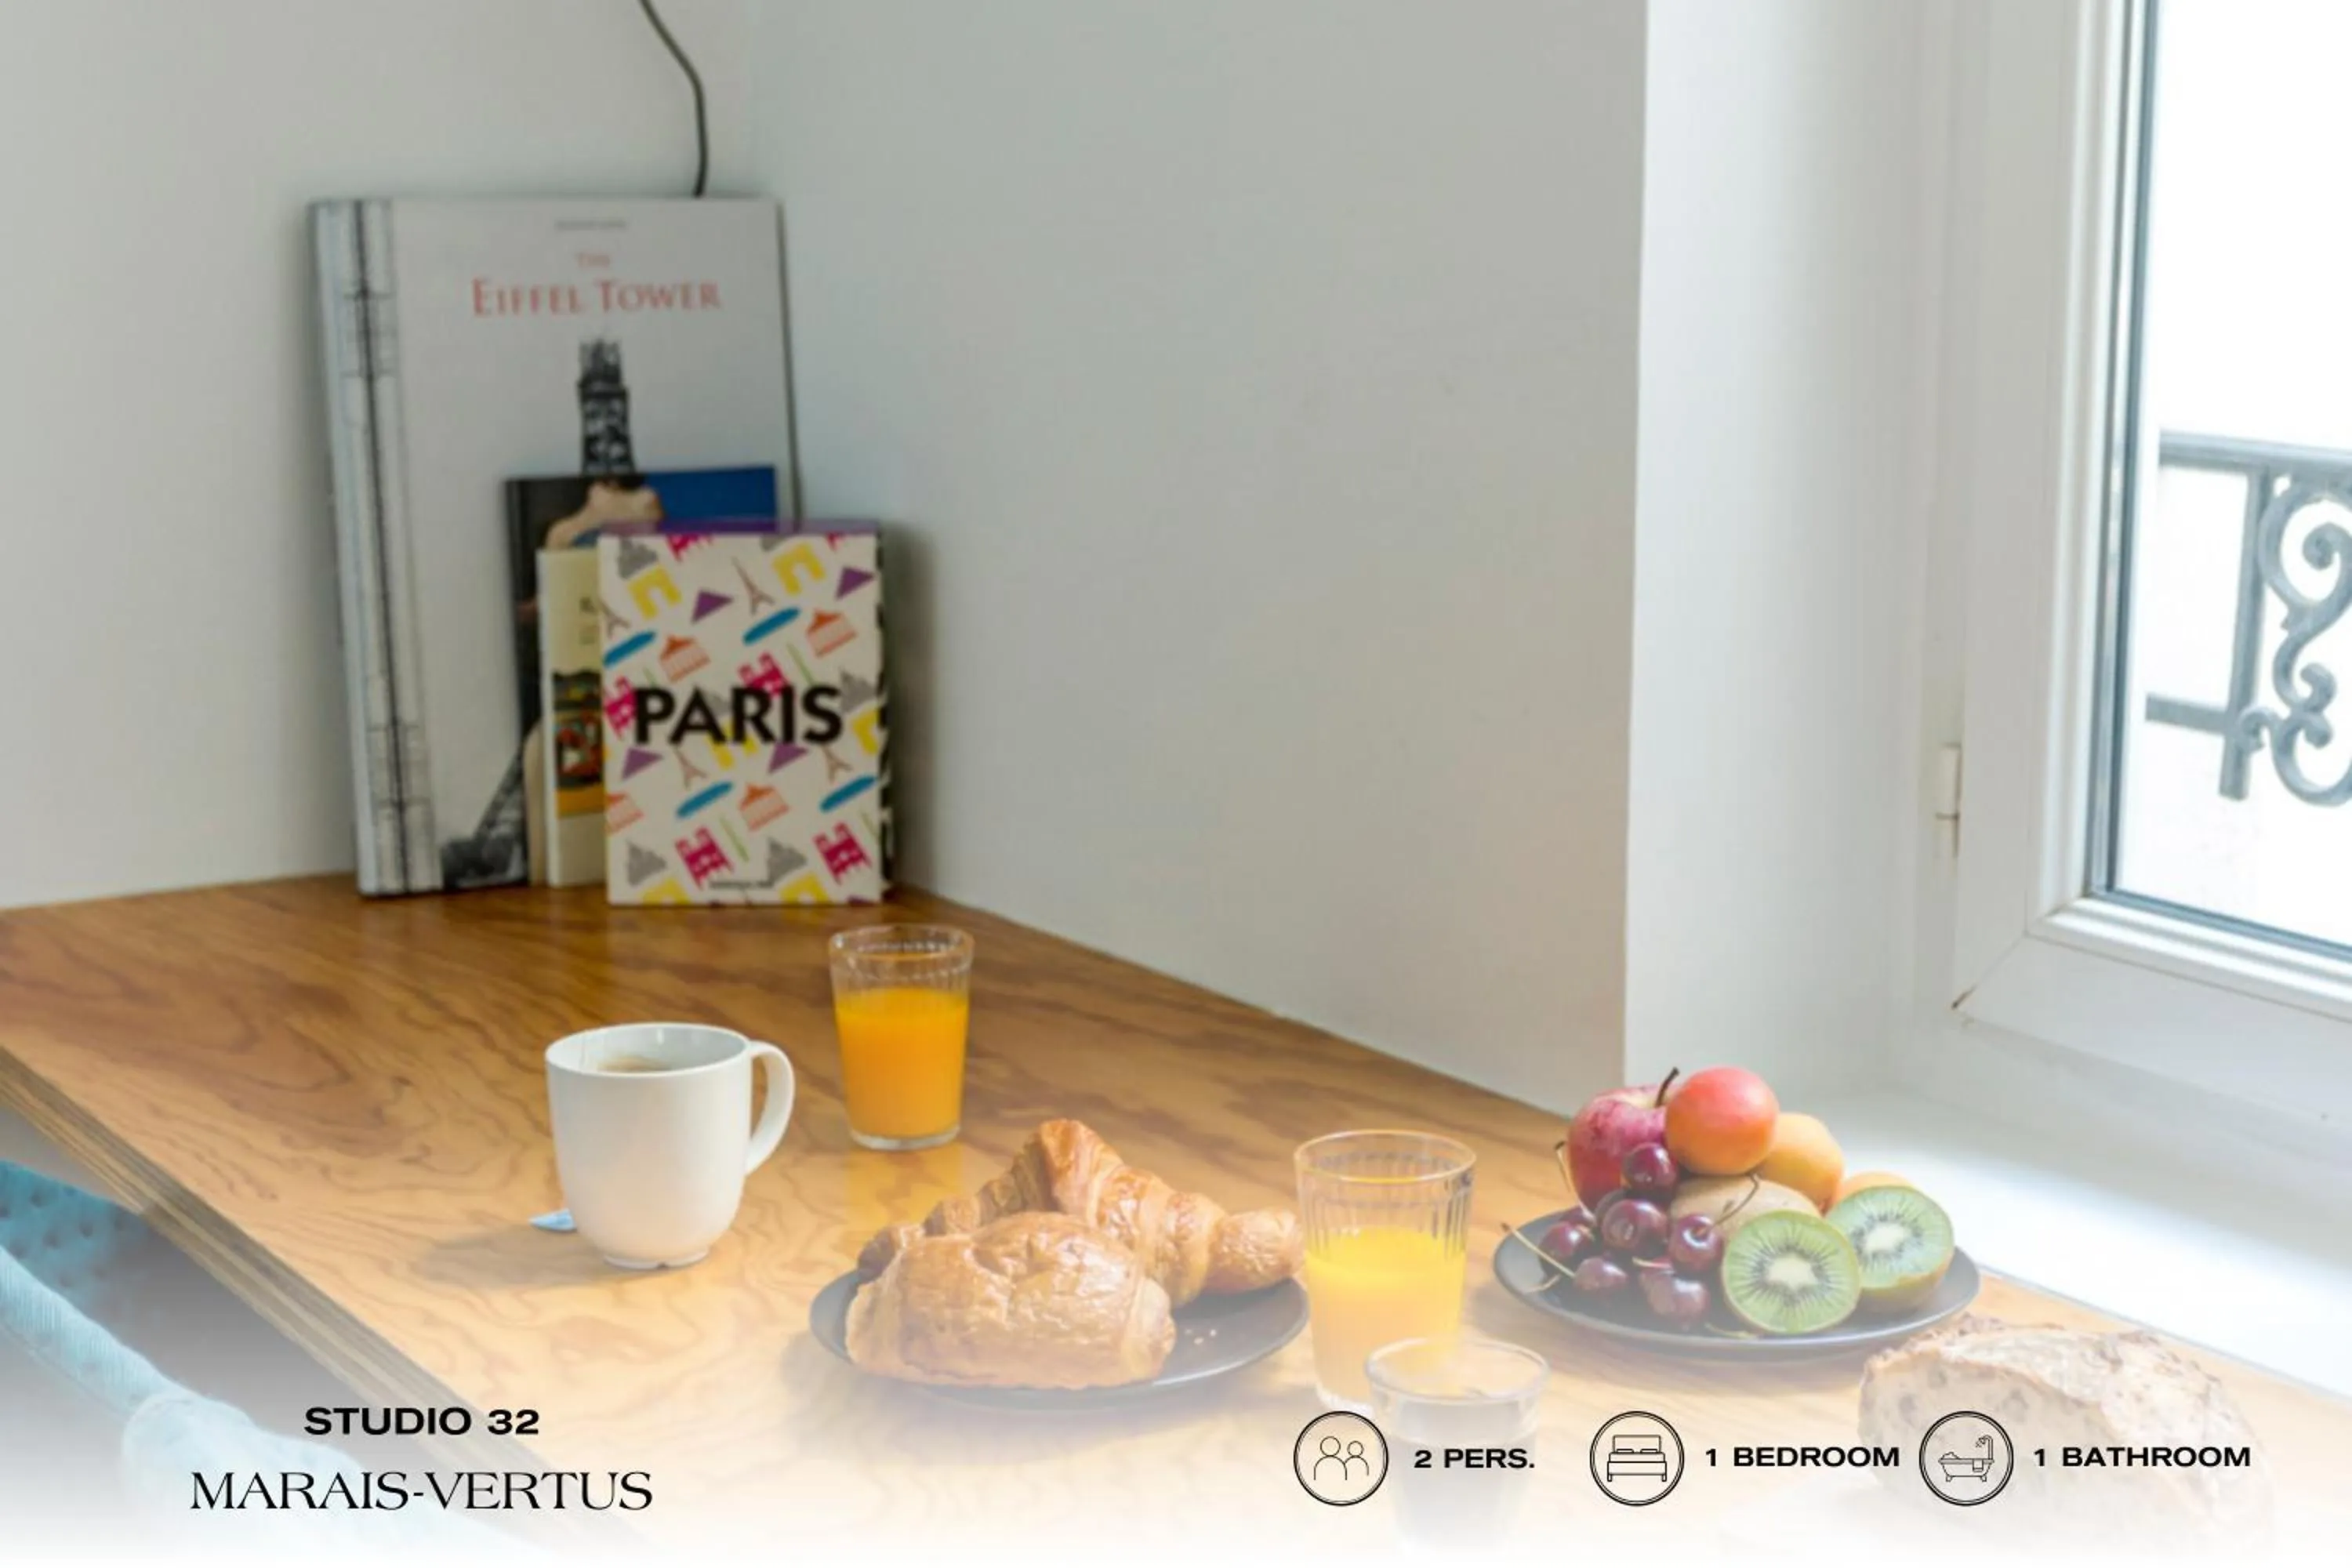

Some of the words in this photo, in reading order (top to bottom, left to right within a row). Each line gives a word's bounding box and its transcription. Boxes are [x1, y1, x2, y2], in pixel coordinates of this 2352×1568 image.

[471, 278, 582, 315] EIFFEL
[594, 278, 722, 312] TOWER
[633, 685, 842, 745] PARIS
